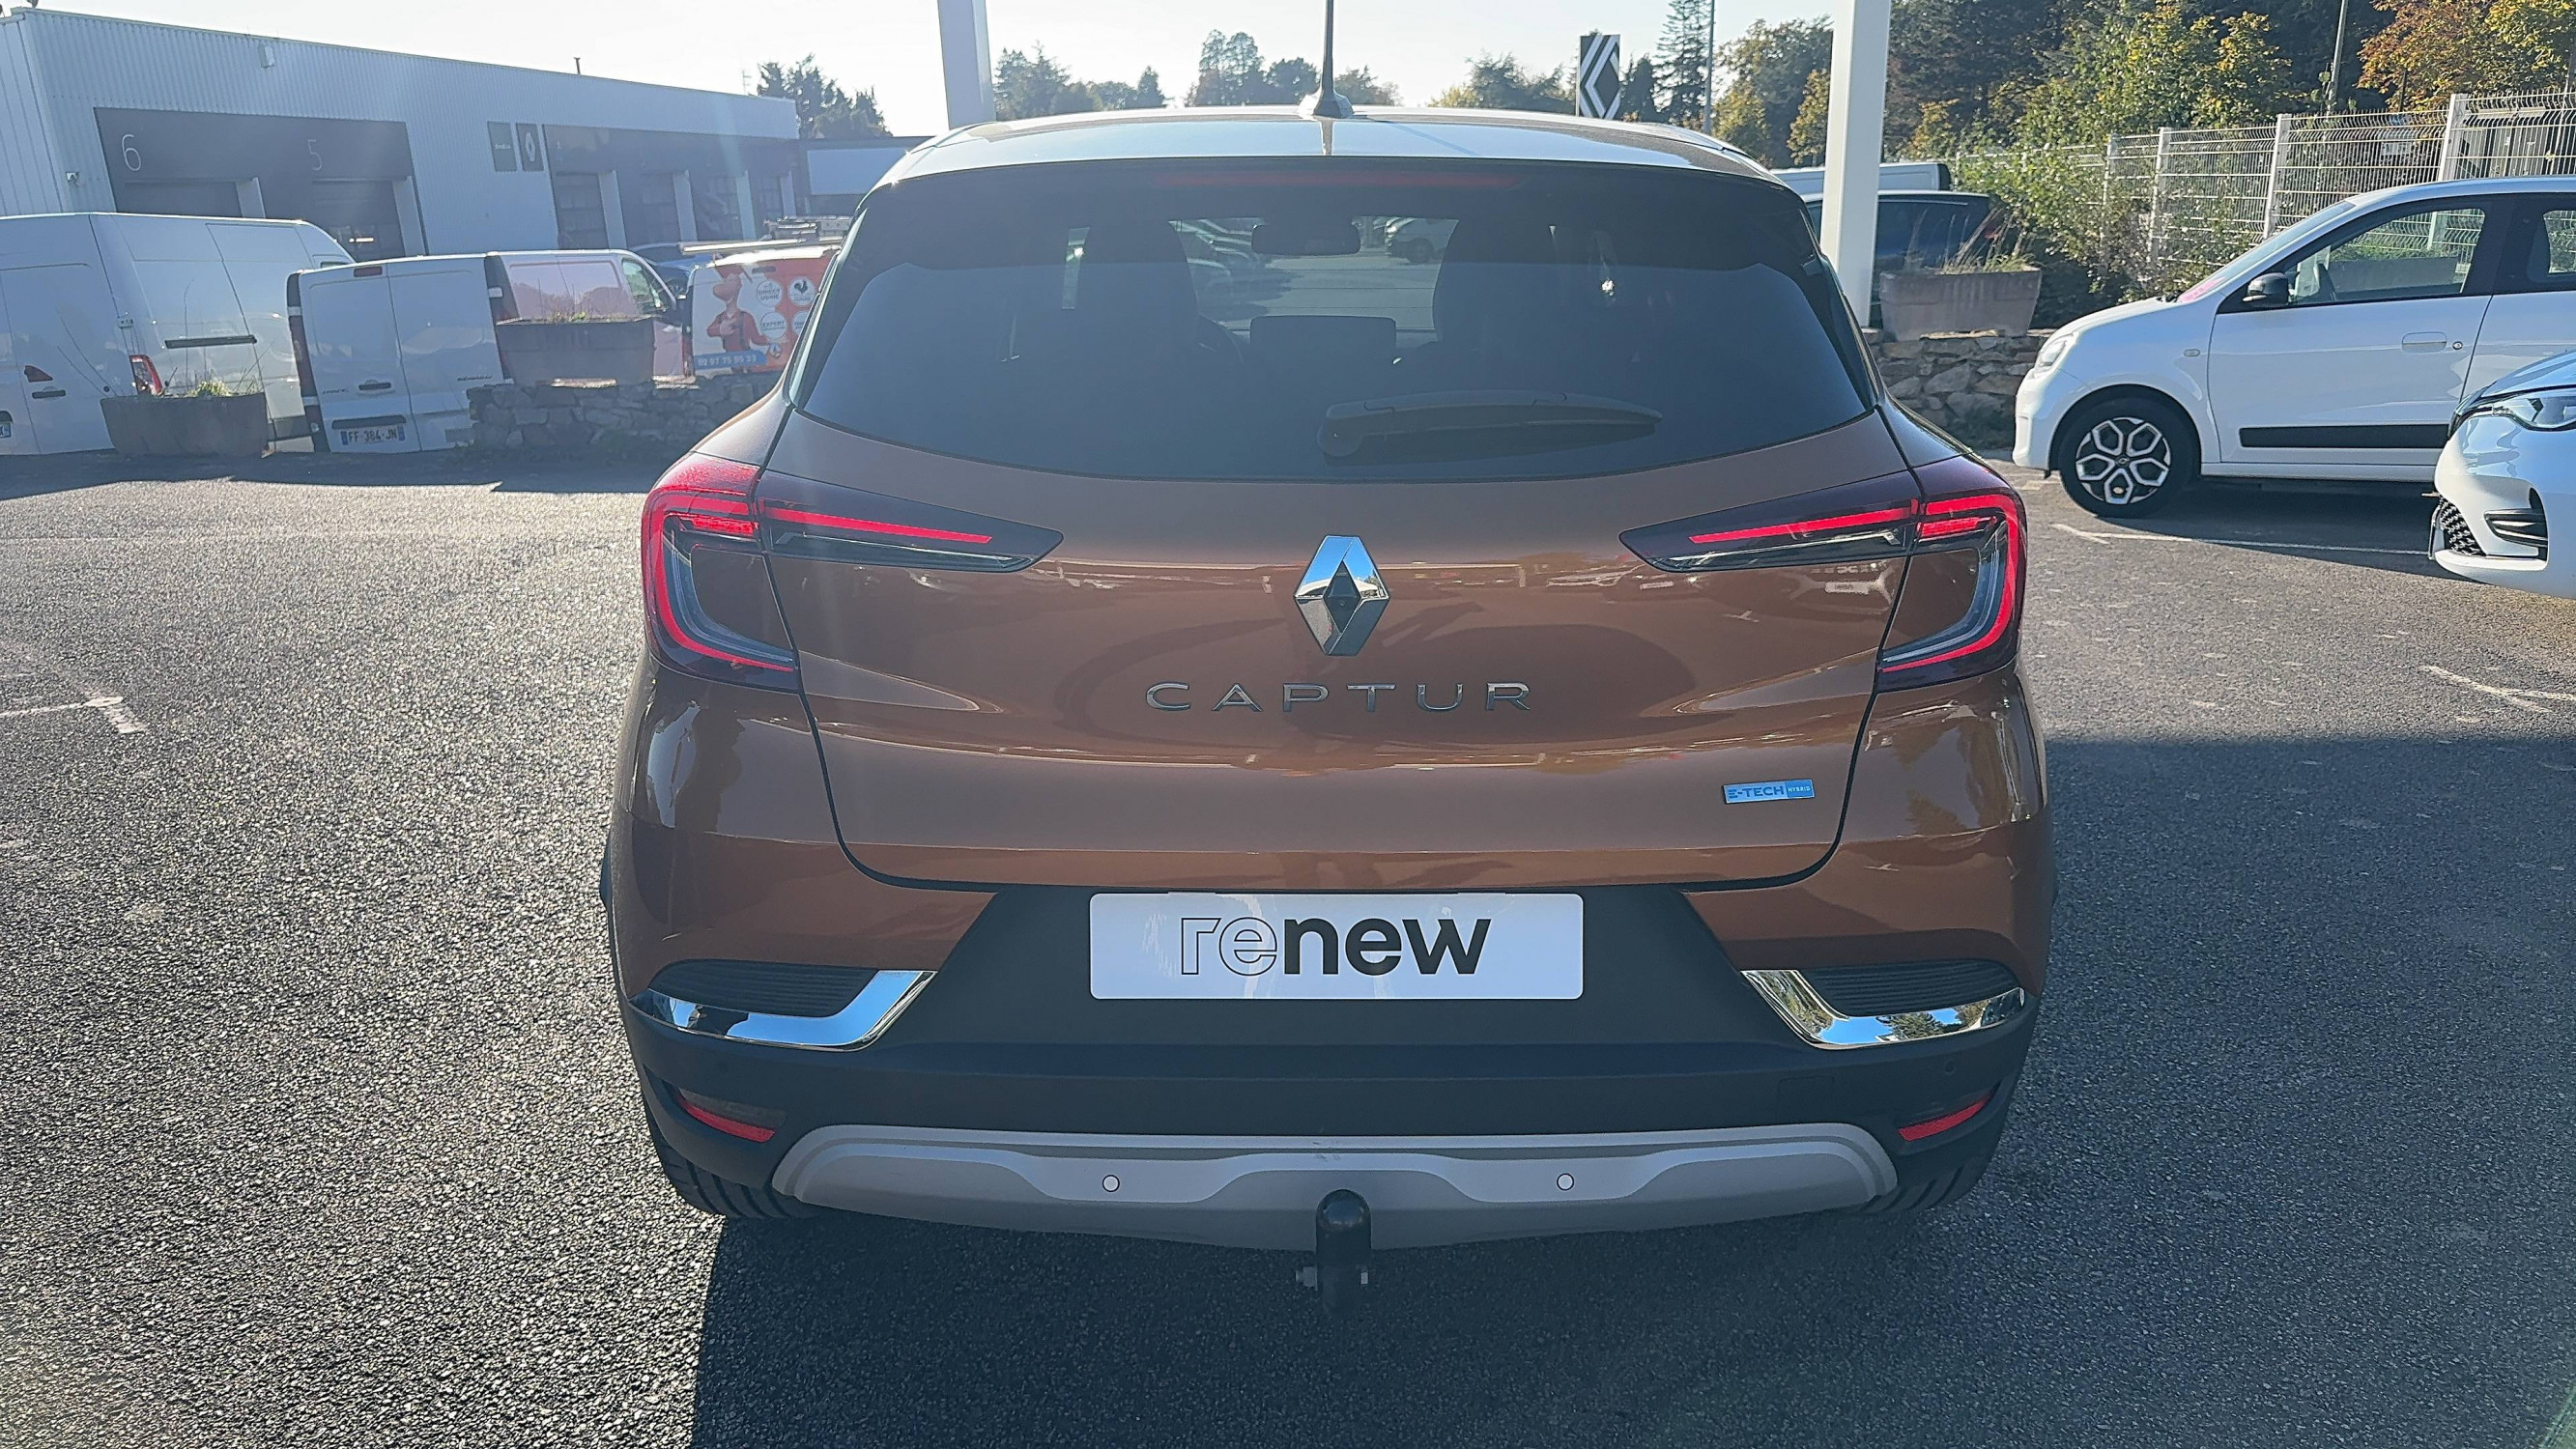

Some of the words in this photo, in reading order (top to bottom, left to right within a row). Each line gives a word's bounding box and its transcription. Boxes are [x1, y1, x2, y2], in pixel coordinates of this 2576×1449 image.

[122, 133, 142, 171] 6
[307, 139, 323, 171] 5
[1145, 681, 1531, 713] CAPTUR
[1727, 785, 1785, 799] E-TECH
[1181, 917, 1492, 977] renew
